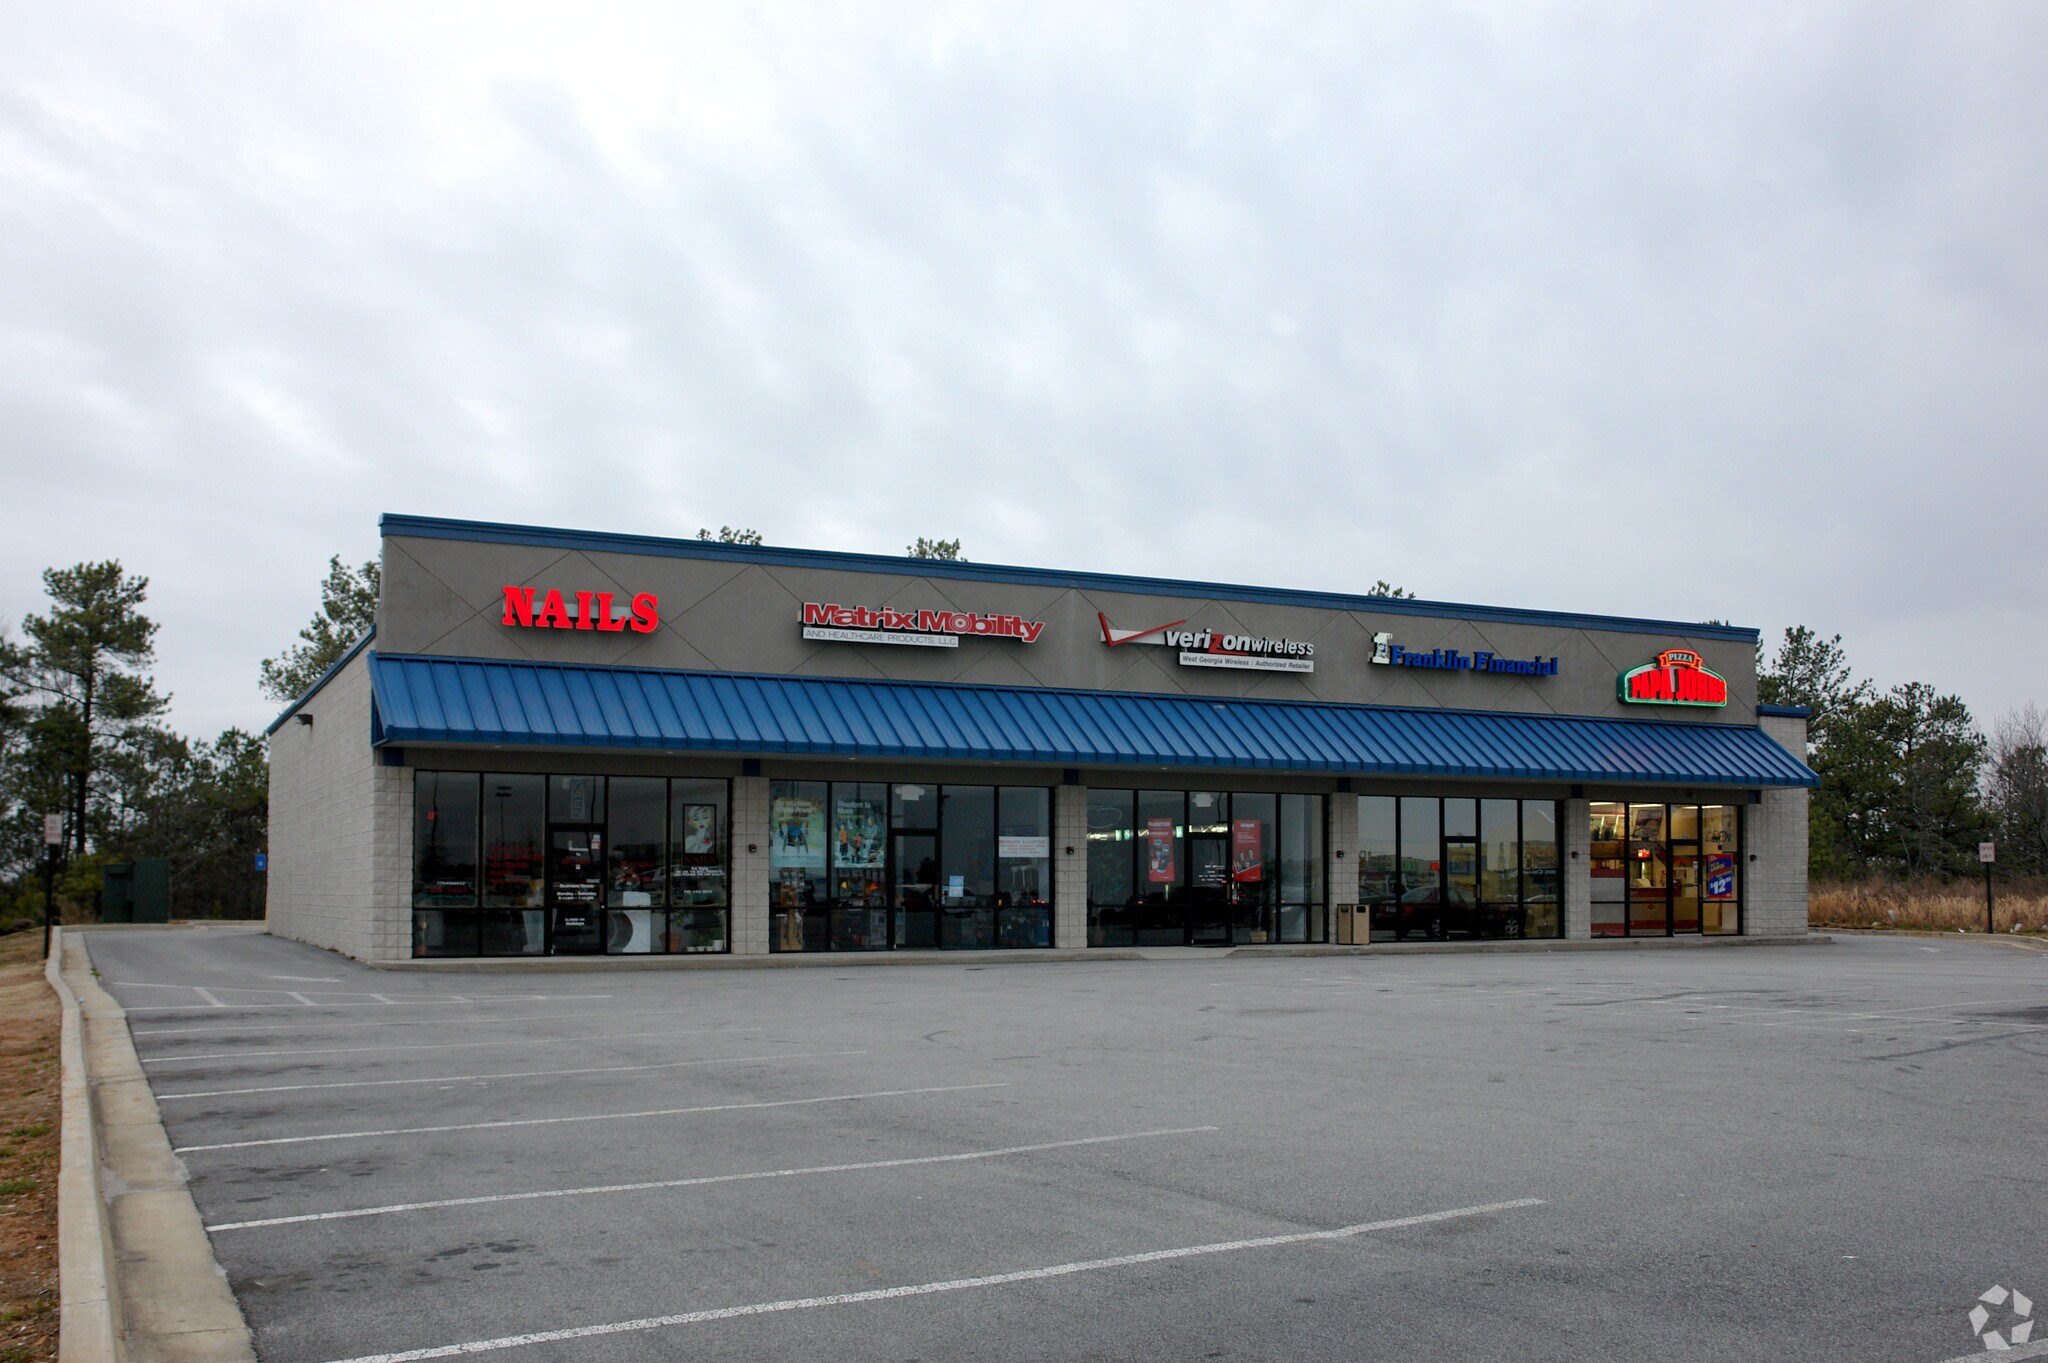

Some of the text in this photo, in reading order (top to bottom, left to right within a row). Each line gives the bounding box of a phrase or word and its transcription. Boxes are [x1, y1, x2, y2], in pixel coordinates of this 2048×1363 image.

[501, 585, 660, 634] NAILS
[803, 602, 1046, 643] Matrix Mobility
[805, 629, 956, 646] AND HEALTHCARE PRODUCTS, LLC
[1182, 655, 1311, 670] West Georgia Wireless Authorized Retailer
[1390, 645, 1471, 670] Franklin
[1473, 651, 1559, 675] Financial
[1668, 653, 1693, 662] PIZZA
[1631, 668, 1674, 699] PAPA
